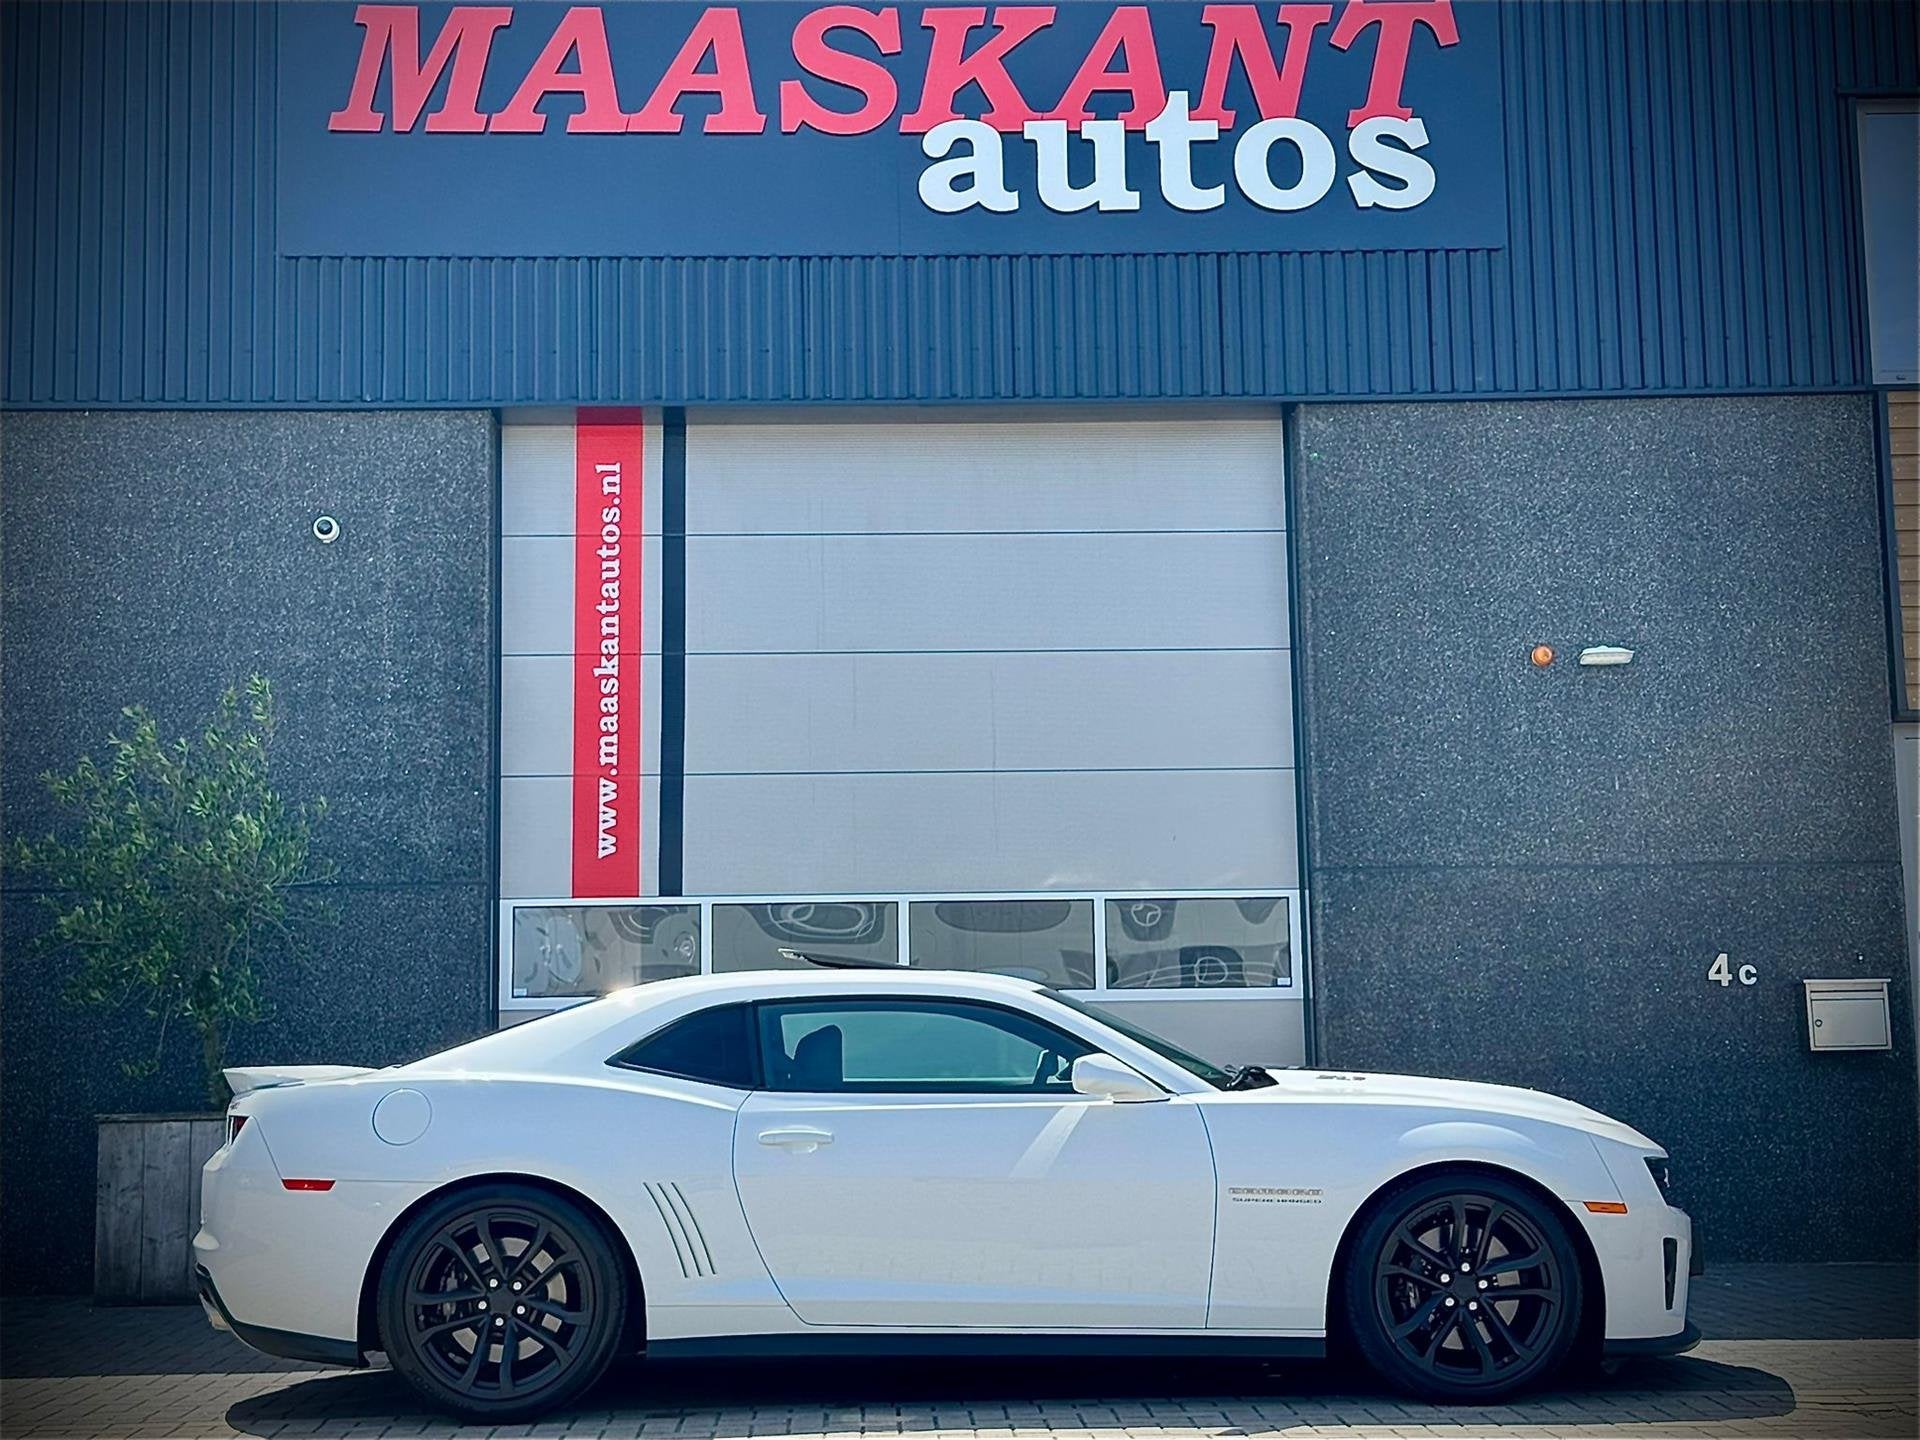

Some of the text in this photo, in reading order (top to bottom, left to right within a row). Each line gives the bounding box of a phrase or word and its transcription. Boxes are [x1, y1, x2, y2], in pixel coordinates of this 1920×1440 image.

[328, 0, 1460, 134] MAASKANT
[918, 91, 1436, 212] autos
[593, 461, 622, 859] www.maaskantautos.nl
